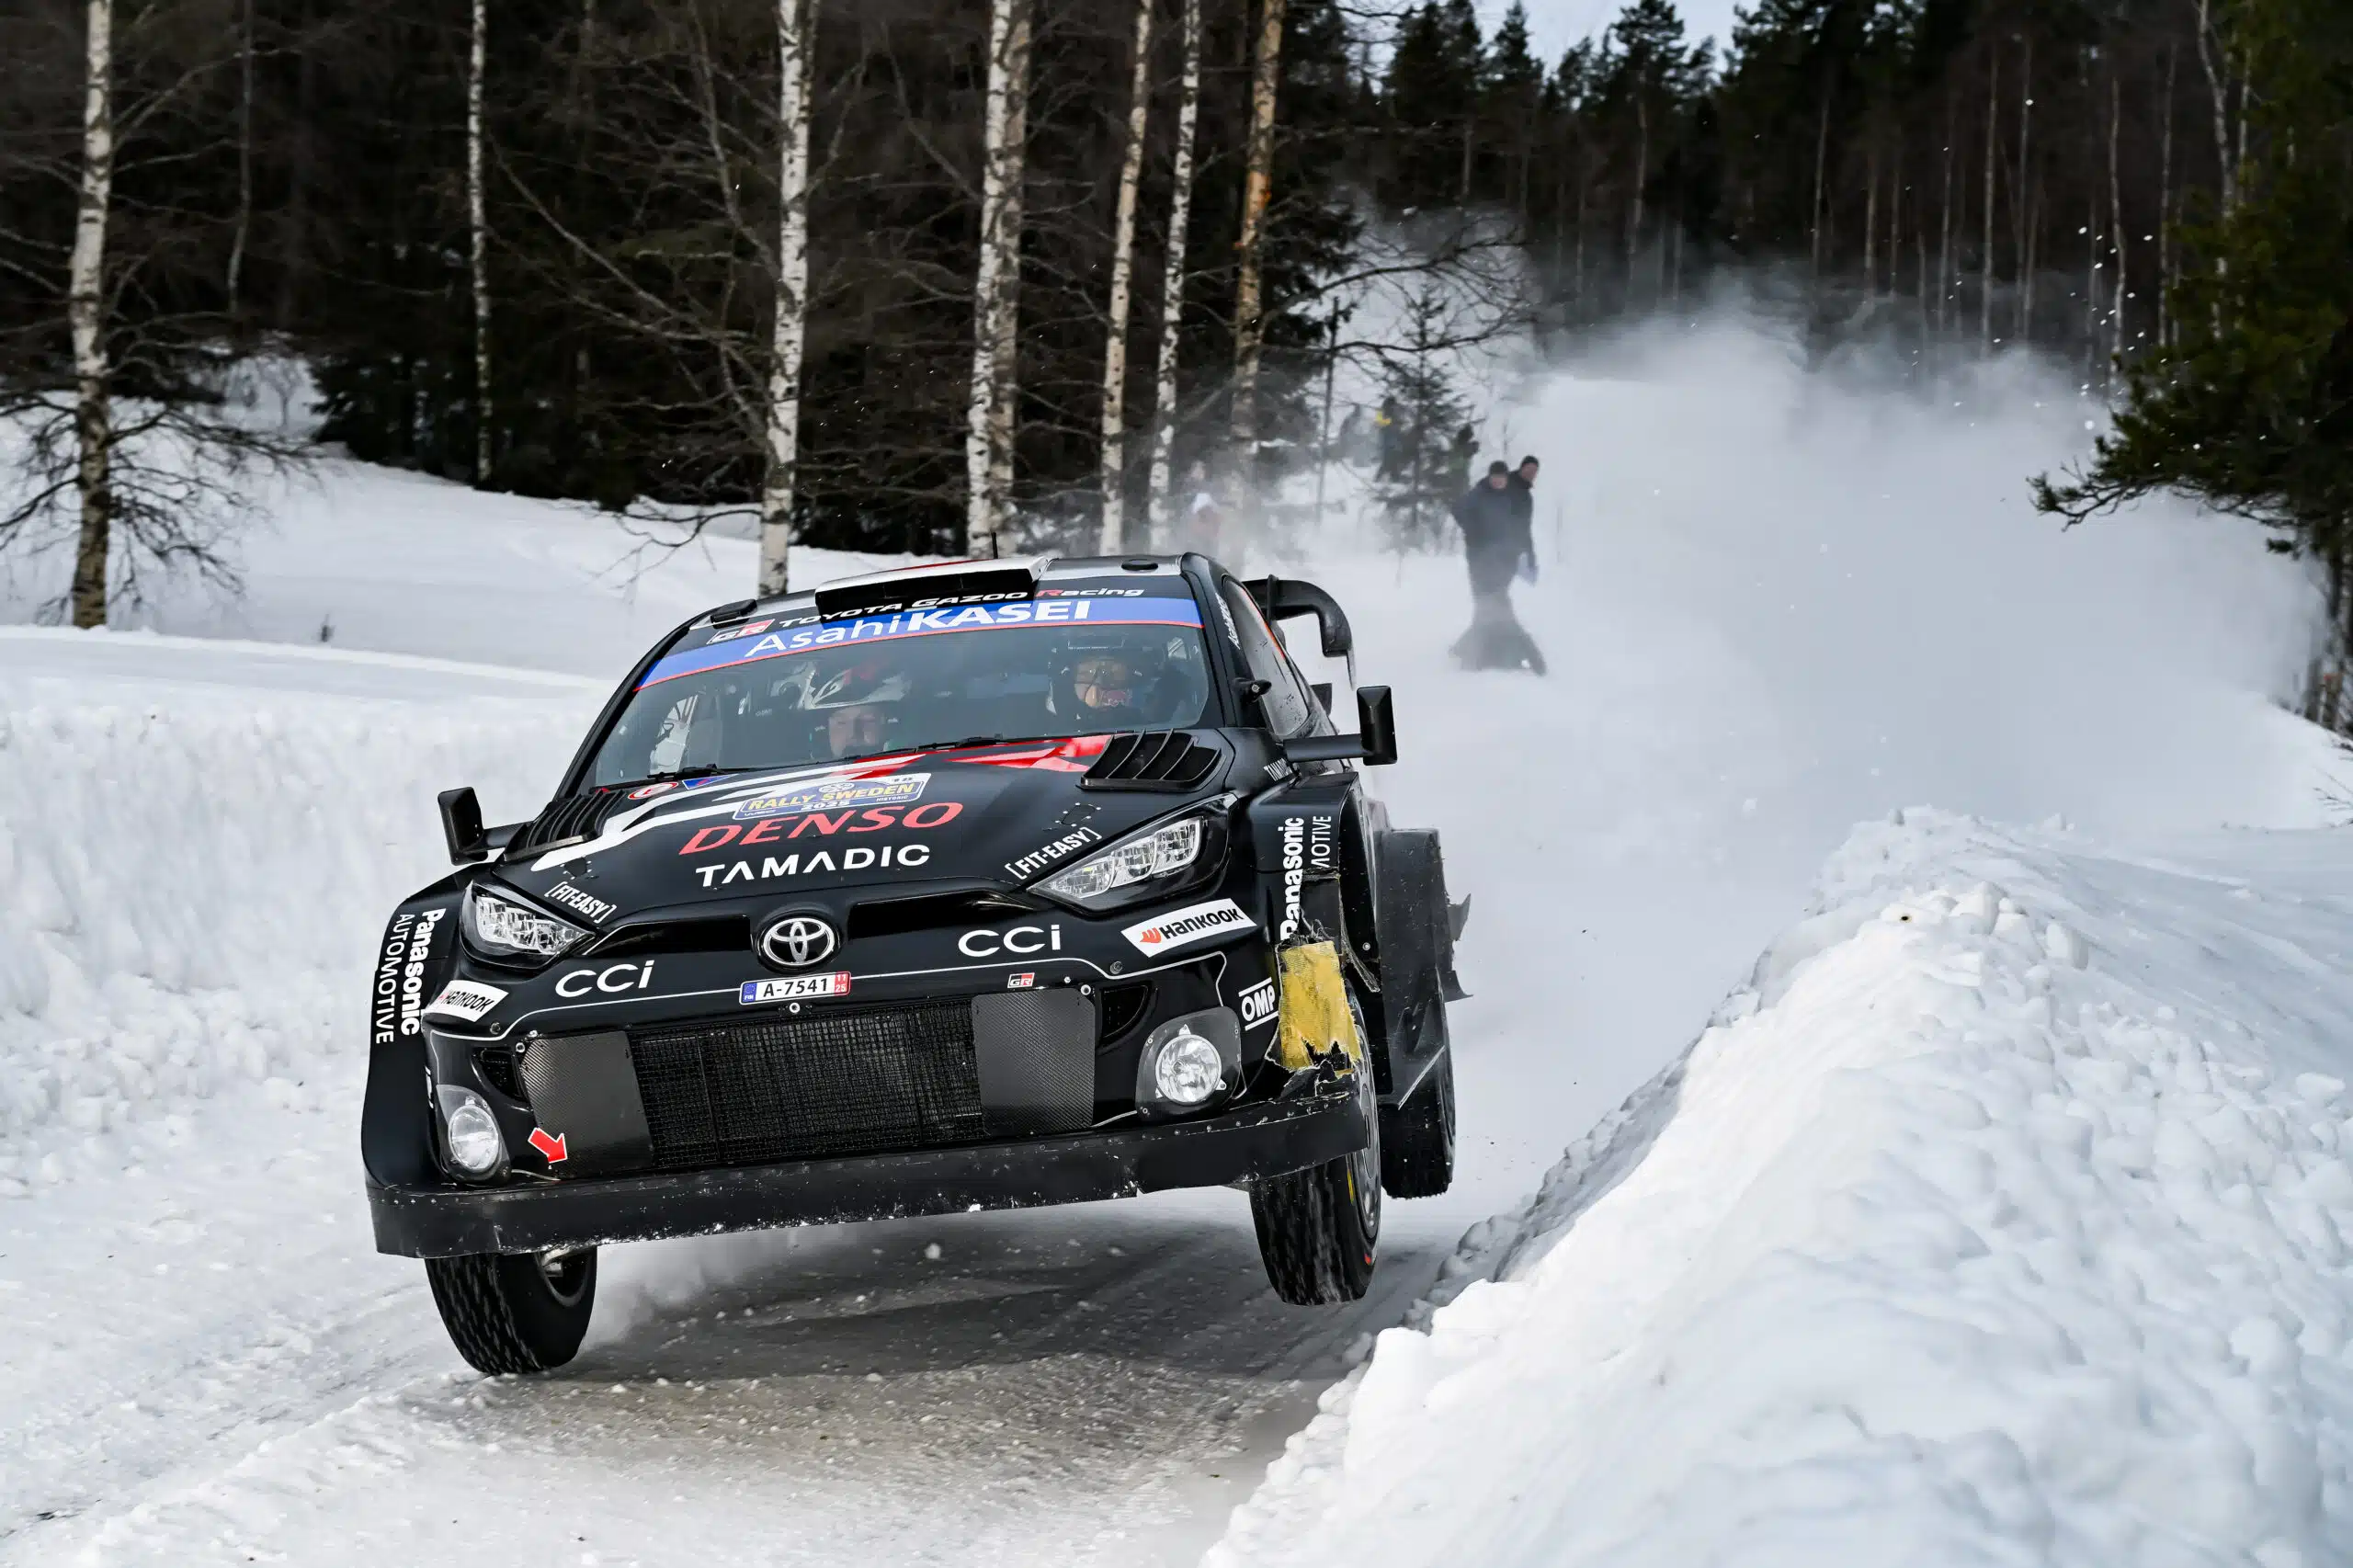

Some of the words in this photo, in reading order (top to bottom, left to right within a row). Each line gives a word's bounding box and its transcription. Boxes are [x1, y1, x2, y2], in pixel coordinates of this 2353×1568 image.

[711, 625, 766, 642] GR
[779, 603, 903, 628] TOYOTA
[911, 591, 1029, 608] GAZOO
[1036, 587, 1144, 597] Racing
[748, 794, 816, 811] RALLY
[821, 782, 915, 801] SWEDEN
[800, 800, 850, 812] 2025
[678, 801, 964, 855] DENSO
[696, 844, 930, 888] TAMADIC
[376, 914, 415, 1044] AUTOMOTIVE
[401, 908, 447, 1036] Panasonic
[763, 978, 827, 997] A-7541
[835, 984, 847, 993] 25
[836, 973, 847, 982] 11
[1010, 977, 1033, 987] GR
[1242, 984, 1276, 1022] OMP
